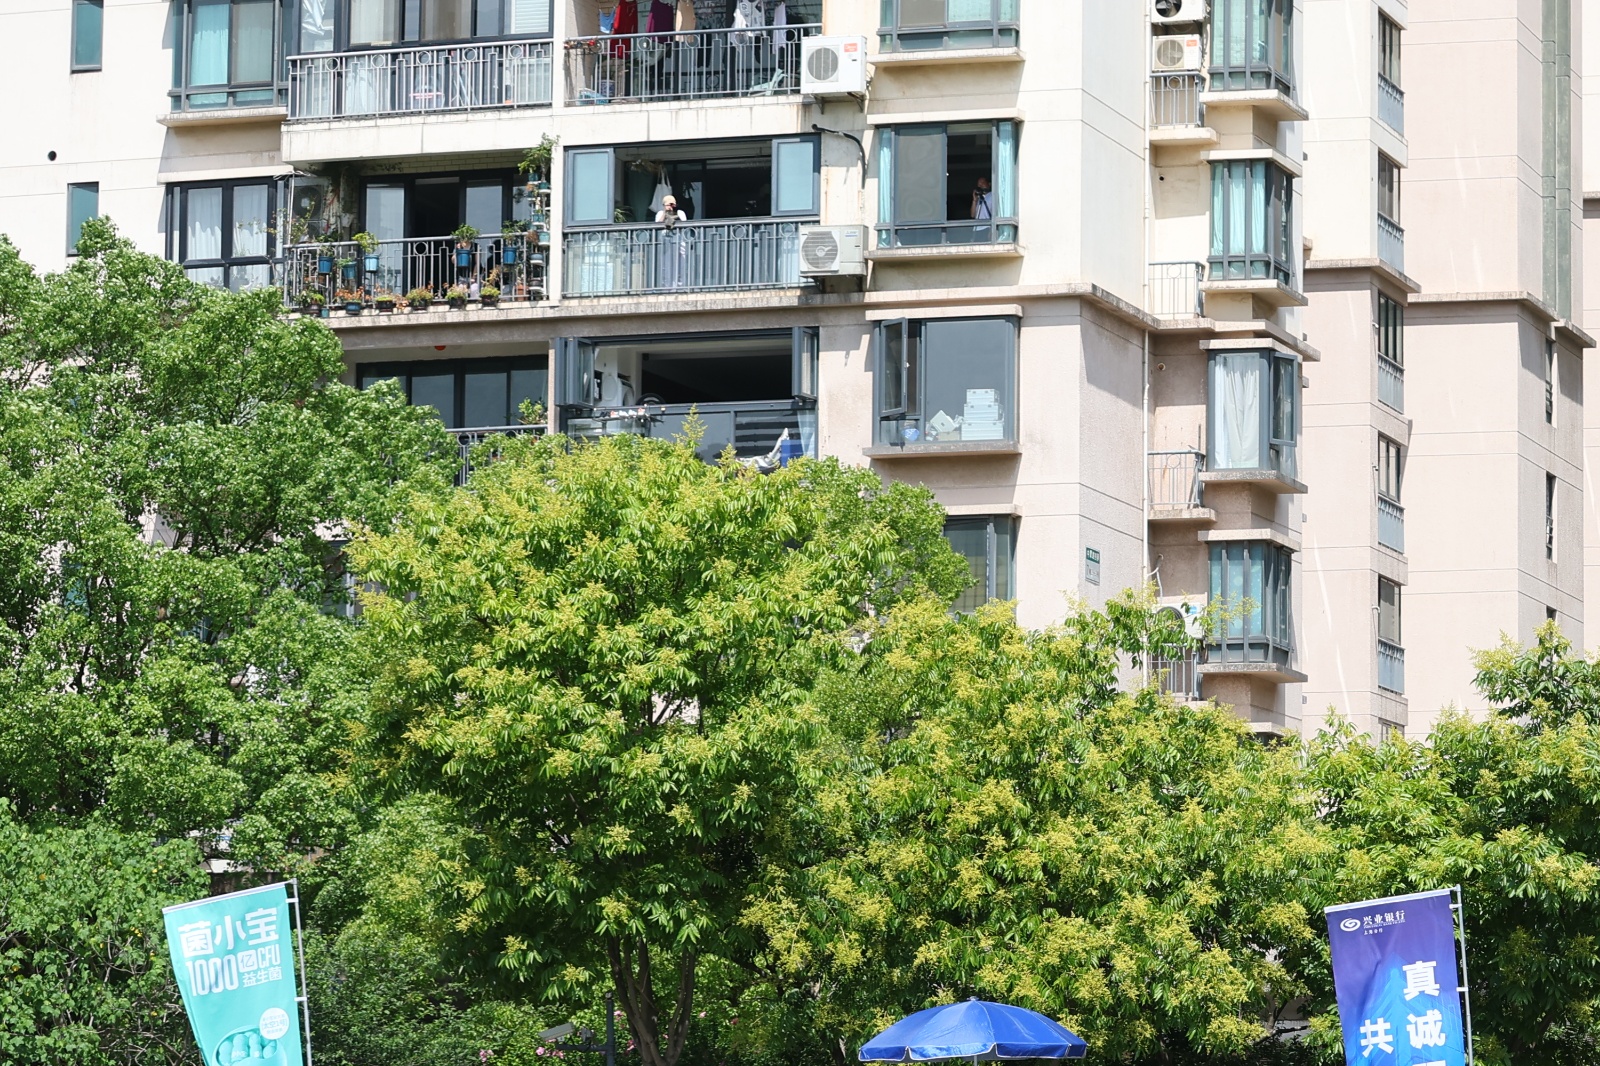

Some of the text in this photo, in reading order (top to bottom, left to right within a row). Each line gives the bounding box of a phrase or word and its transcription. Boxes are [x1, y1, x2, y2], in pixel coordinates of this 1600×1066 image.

[1363, 910, 1405, 925] 兴业银行
[178, 907, 279, 958] 菌小宝
[242, 966, 282, 988] 益生菌
